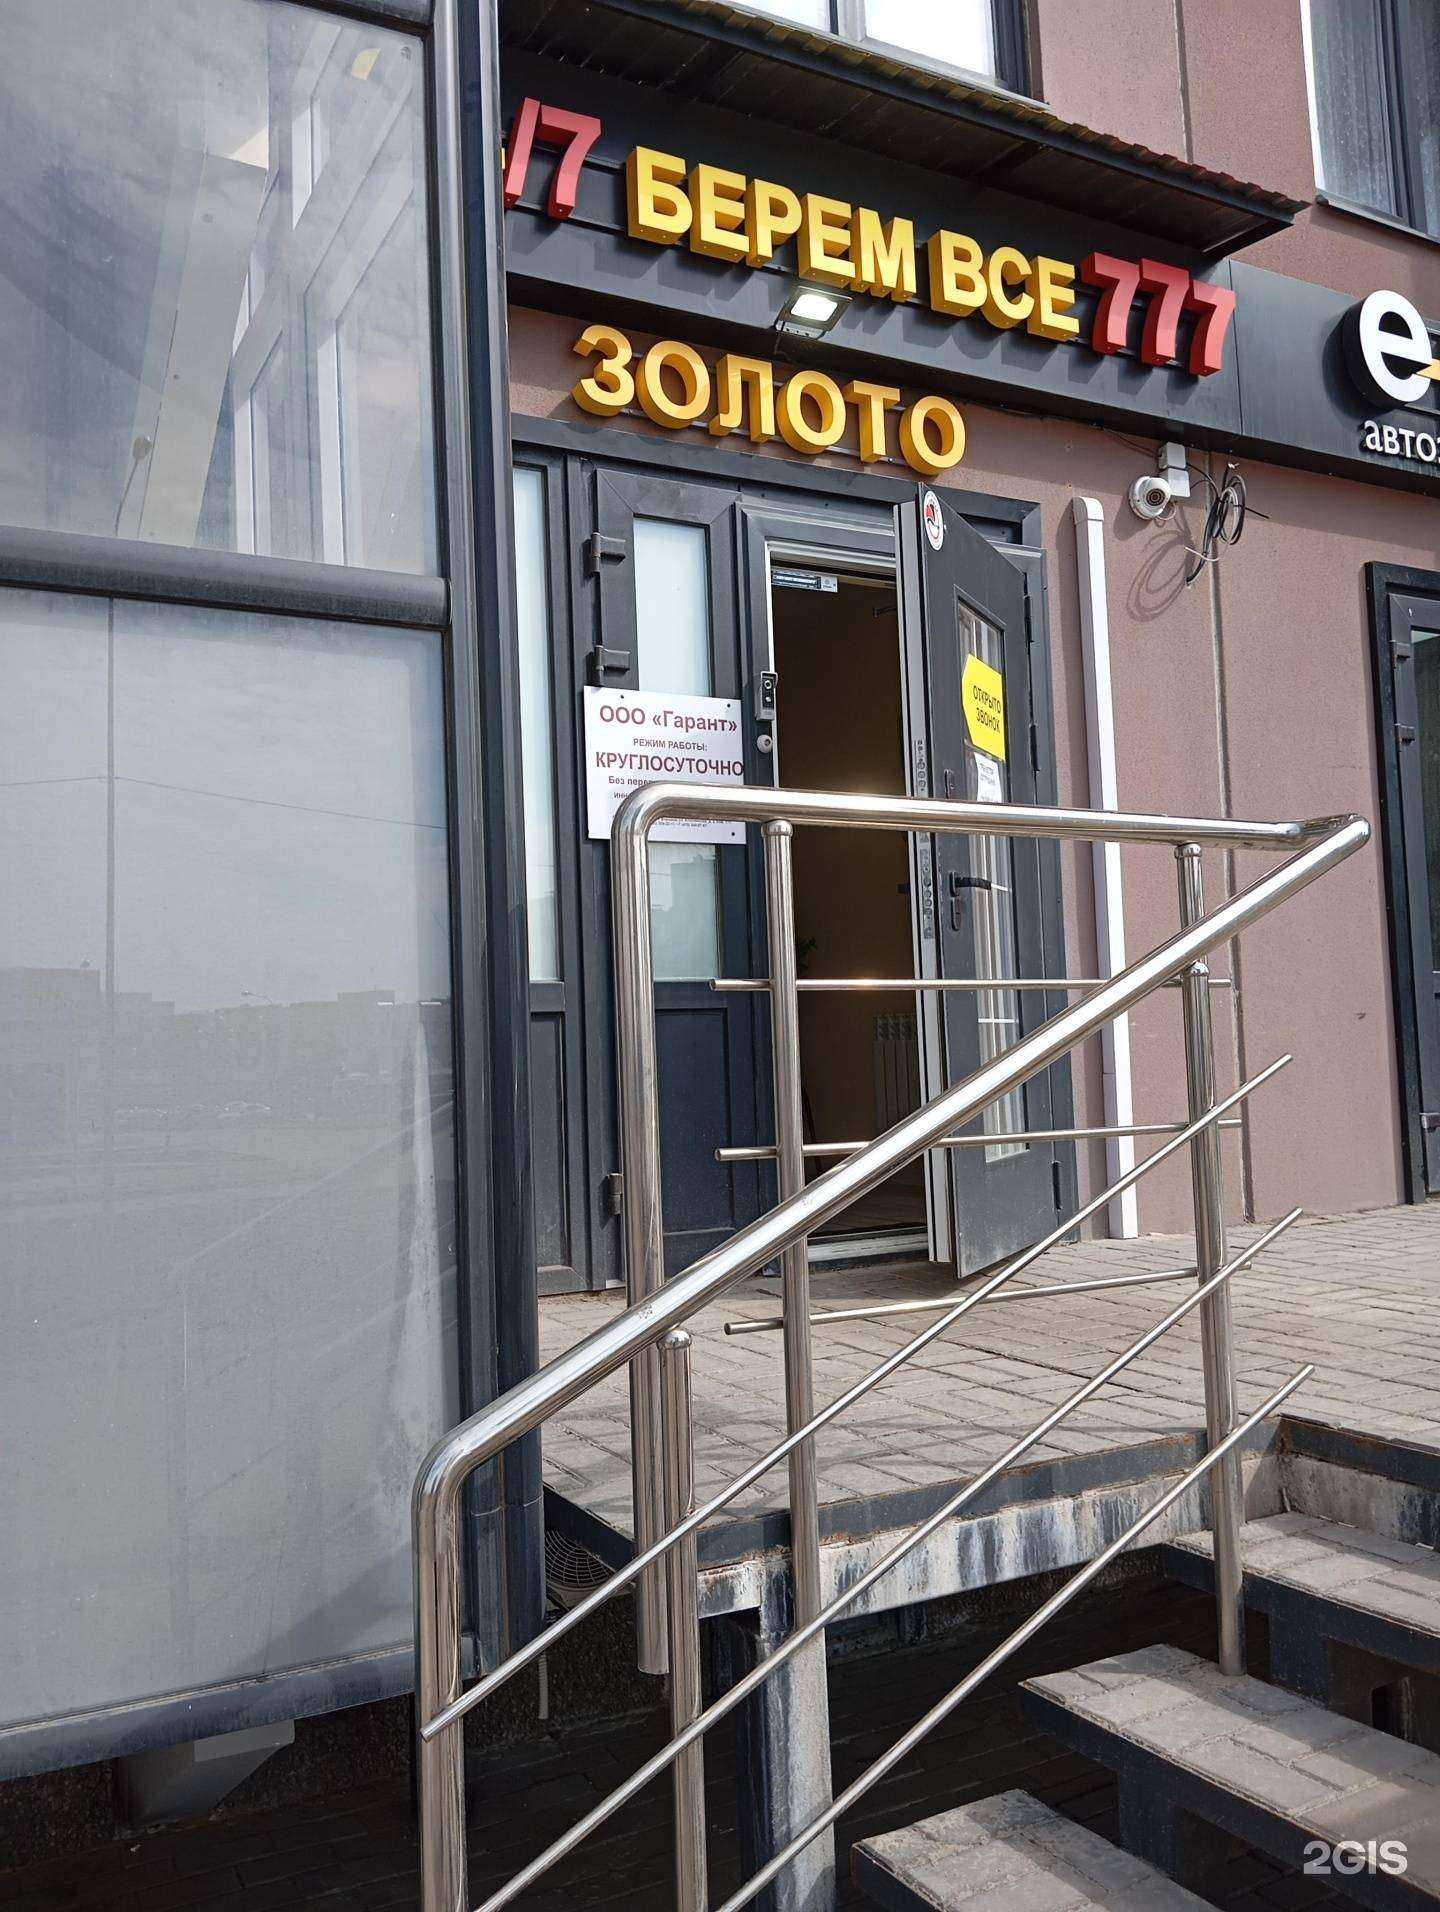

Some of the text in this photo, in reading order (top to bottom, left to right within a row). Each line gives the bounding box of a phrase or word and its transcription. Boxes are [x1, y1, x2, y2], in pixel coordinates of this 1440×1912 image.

[626, 146, 917, 302] БЕРЕМ
[928, 229, 1080, 342] ВСЕ
[1081, 252, 1236, 377] 777
[572, 325, 966, 476] ЗОЛОТО
[1363, 419, 1440, 464] авто
[973, 685, 1001, 714] ОТКРЫТО
[599, 705, 738, 732] ООО «Гарант»
[976, 707, 1001, 734] ЗВОНОК
[633, 738, 708, 751] РЕЖИМ РАБОТЫ:
[595, 751, 744, 776] КРУГЛОСУТОЧНО
[608, 776, 625, 785] Без
